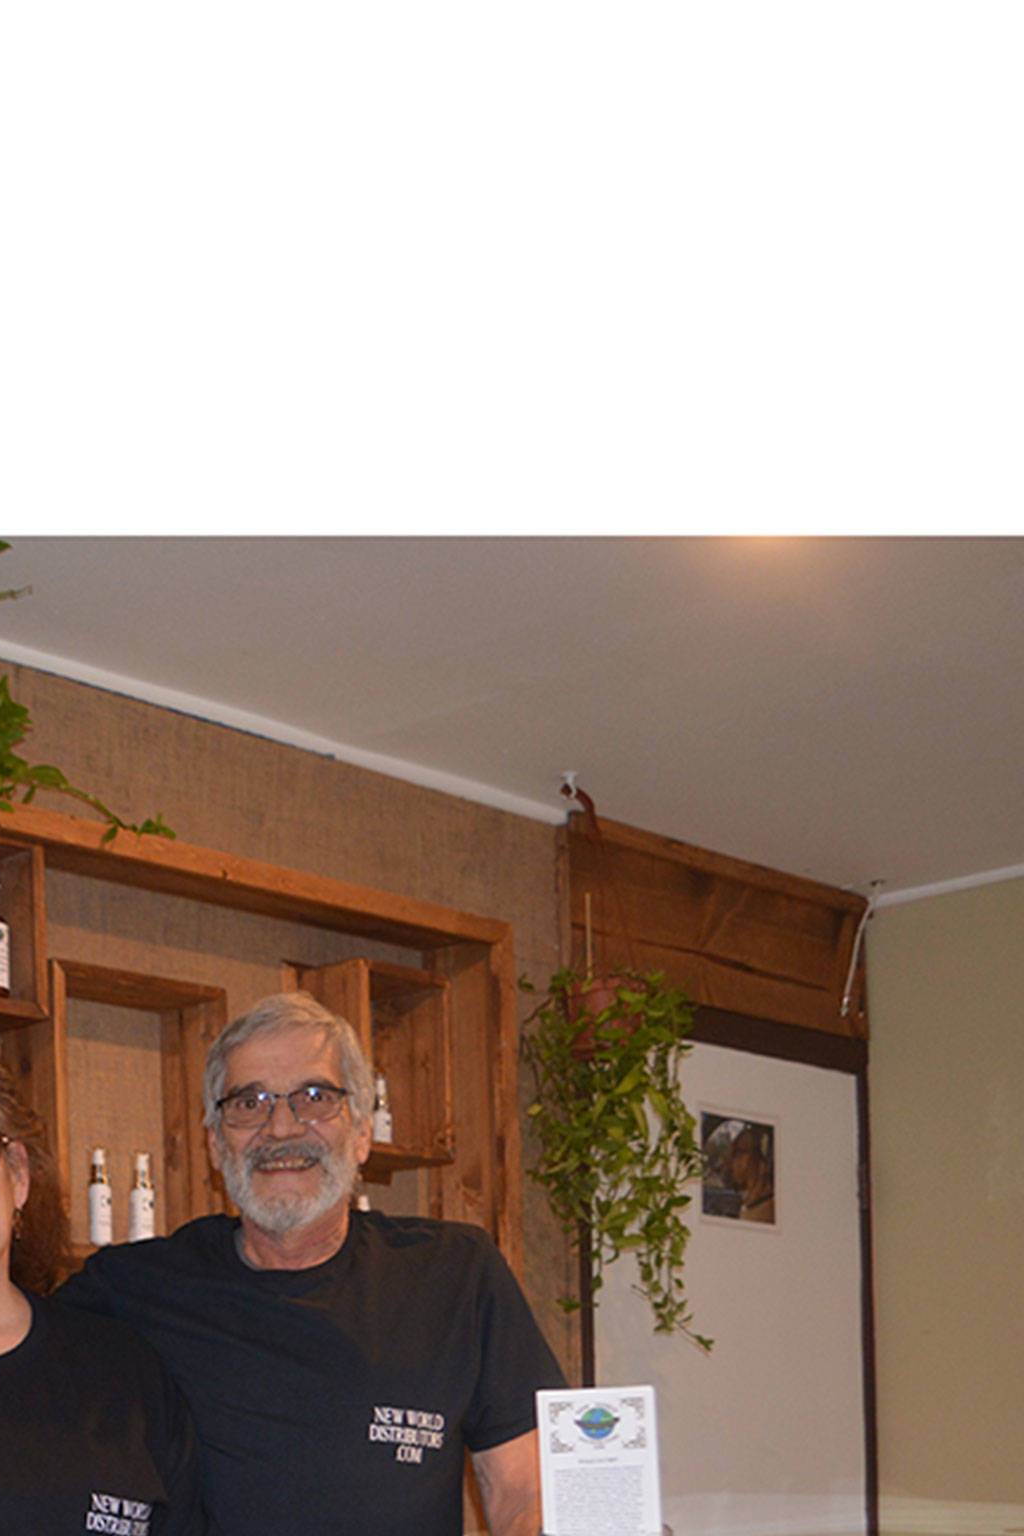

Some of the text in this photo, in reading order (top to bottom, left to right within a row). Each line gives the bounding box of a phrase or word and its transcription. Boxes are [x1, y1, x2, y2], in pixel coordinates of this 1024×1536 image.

[374, 1406, 445, 1431] NEW WORLD
[91, 1493, 121, 1514] NEW
